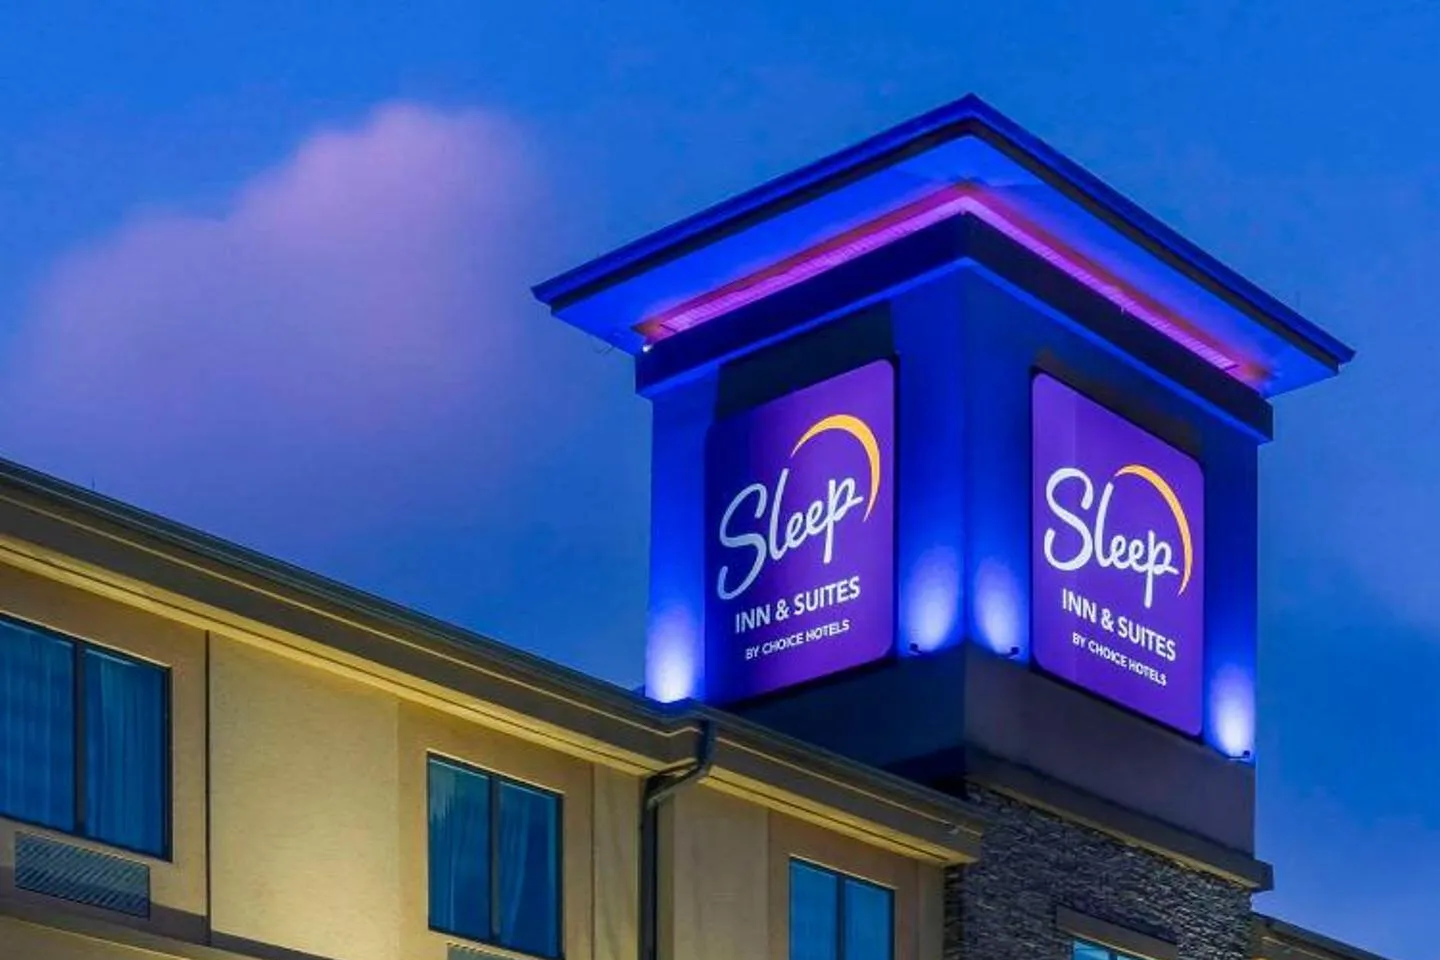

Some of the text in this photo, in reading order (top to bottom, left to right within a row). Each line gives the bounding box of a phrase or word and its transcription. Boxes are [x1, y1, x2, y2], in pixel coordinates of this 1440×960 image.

[717, 468, 863, 600] Sleep
[1043, 467, 1179, 608] Sleep
[735, 575, 861, 634] INN & SUITES
[1062, 588, 1176, 662] INN & SUITES
[745, 618, 850, 660] BY CHOICE HOTELS
[1072, 631, 1167, 687] BY CHOICE HOTELS
